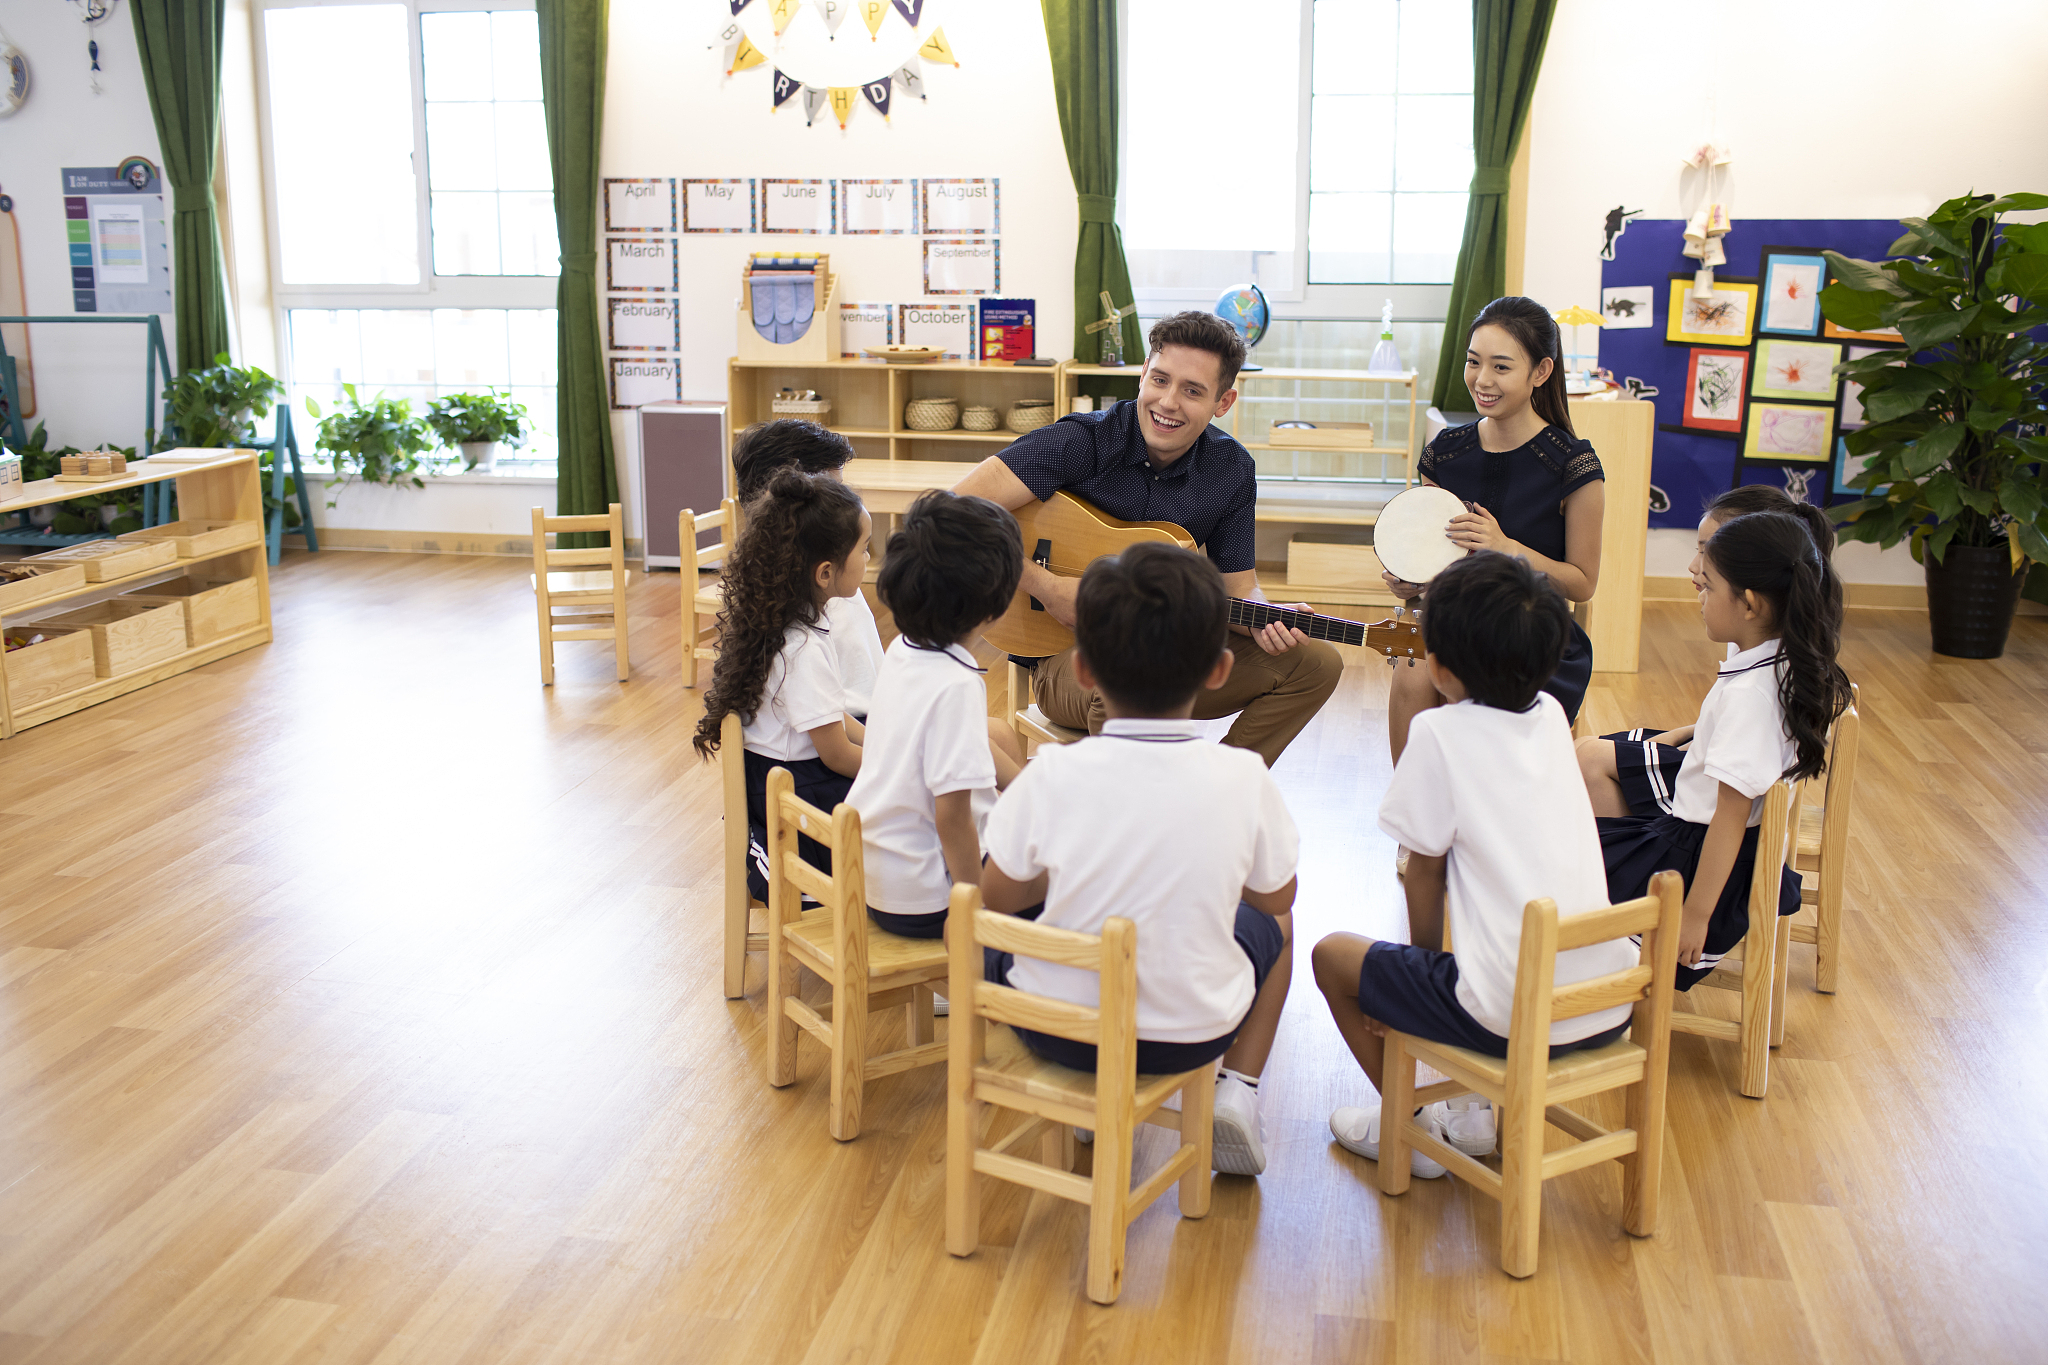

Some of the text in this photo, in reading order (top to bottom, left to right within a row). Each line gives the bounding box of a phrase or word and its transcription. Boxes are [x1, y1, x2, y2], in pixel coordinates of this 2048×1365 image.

[721, 23, 944, 110] BIRTHDAY
[625, 184, 656, 199] April
[705, 184, 735, 200] May
[782, 184, 817, 198] June
[866, 185, 895, 201] July
[936, 184, 988, 200] August
[620, 244, 665, 258] March
[934, 247, 991, 260] September
[612, 302, 675, 320] February
[840, 311, 886, 323] vember
[909, 310, 966, 324] October
[615, 364, 674, 380] January
